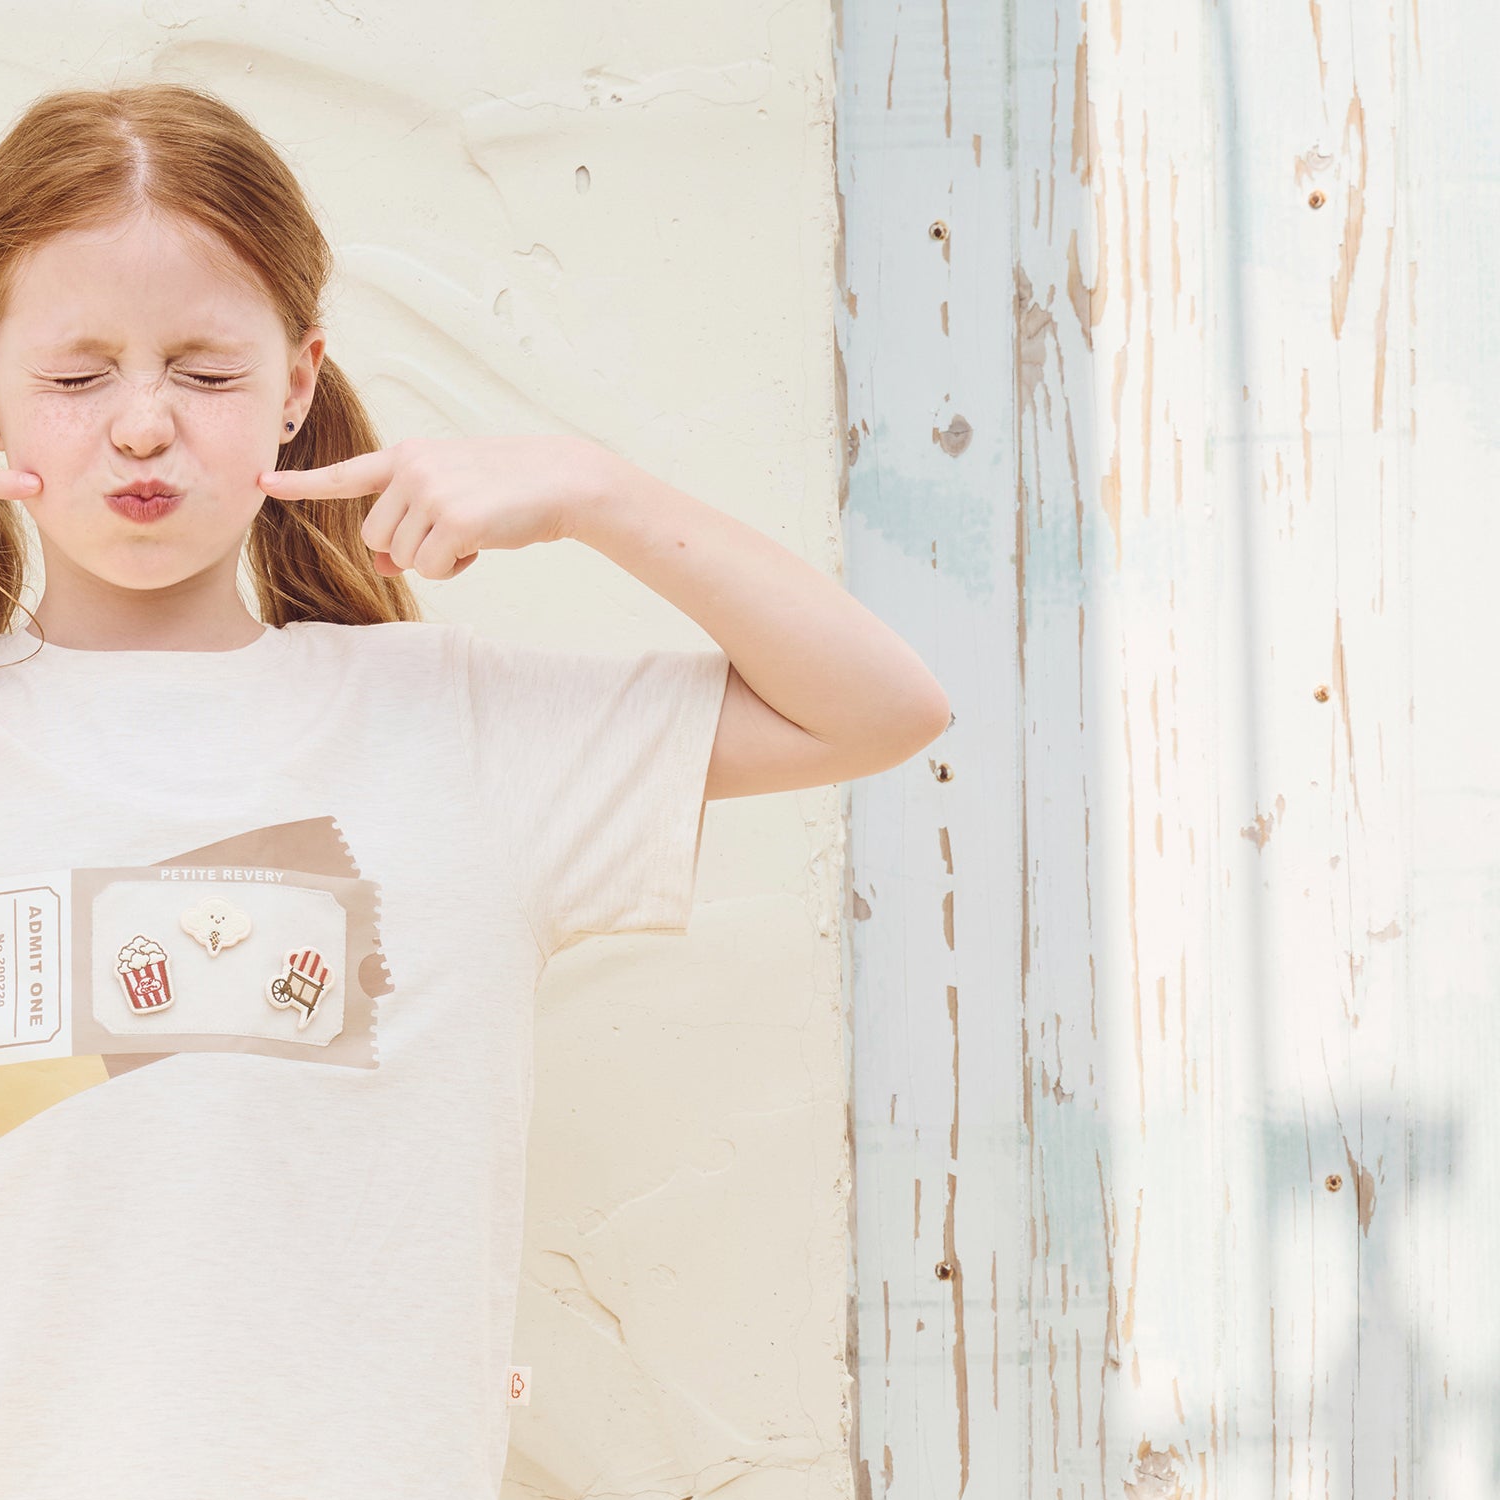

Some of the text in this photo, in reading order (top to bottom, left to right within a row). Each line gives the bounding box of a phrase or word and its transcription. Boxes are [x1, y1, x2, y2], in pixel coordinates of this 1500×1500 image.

[160, 869, 284, 883] PETITE REVERY
[29, 906, 43, 1027] ADMIT ONE
